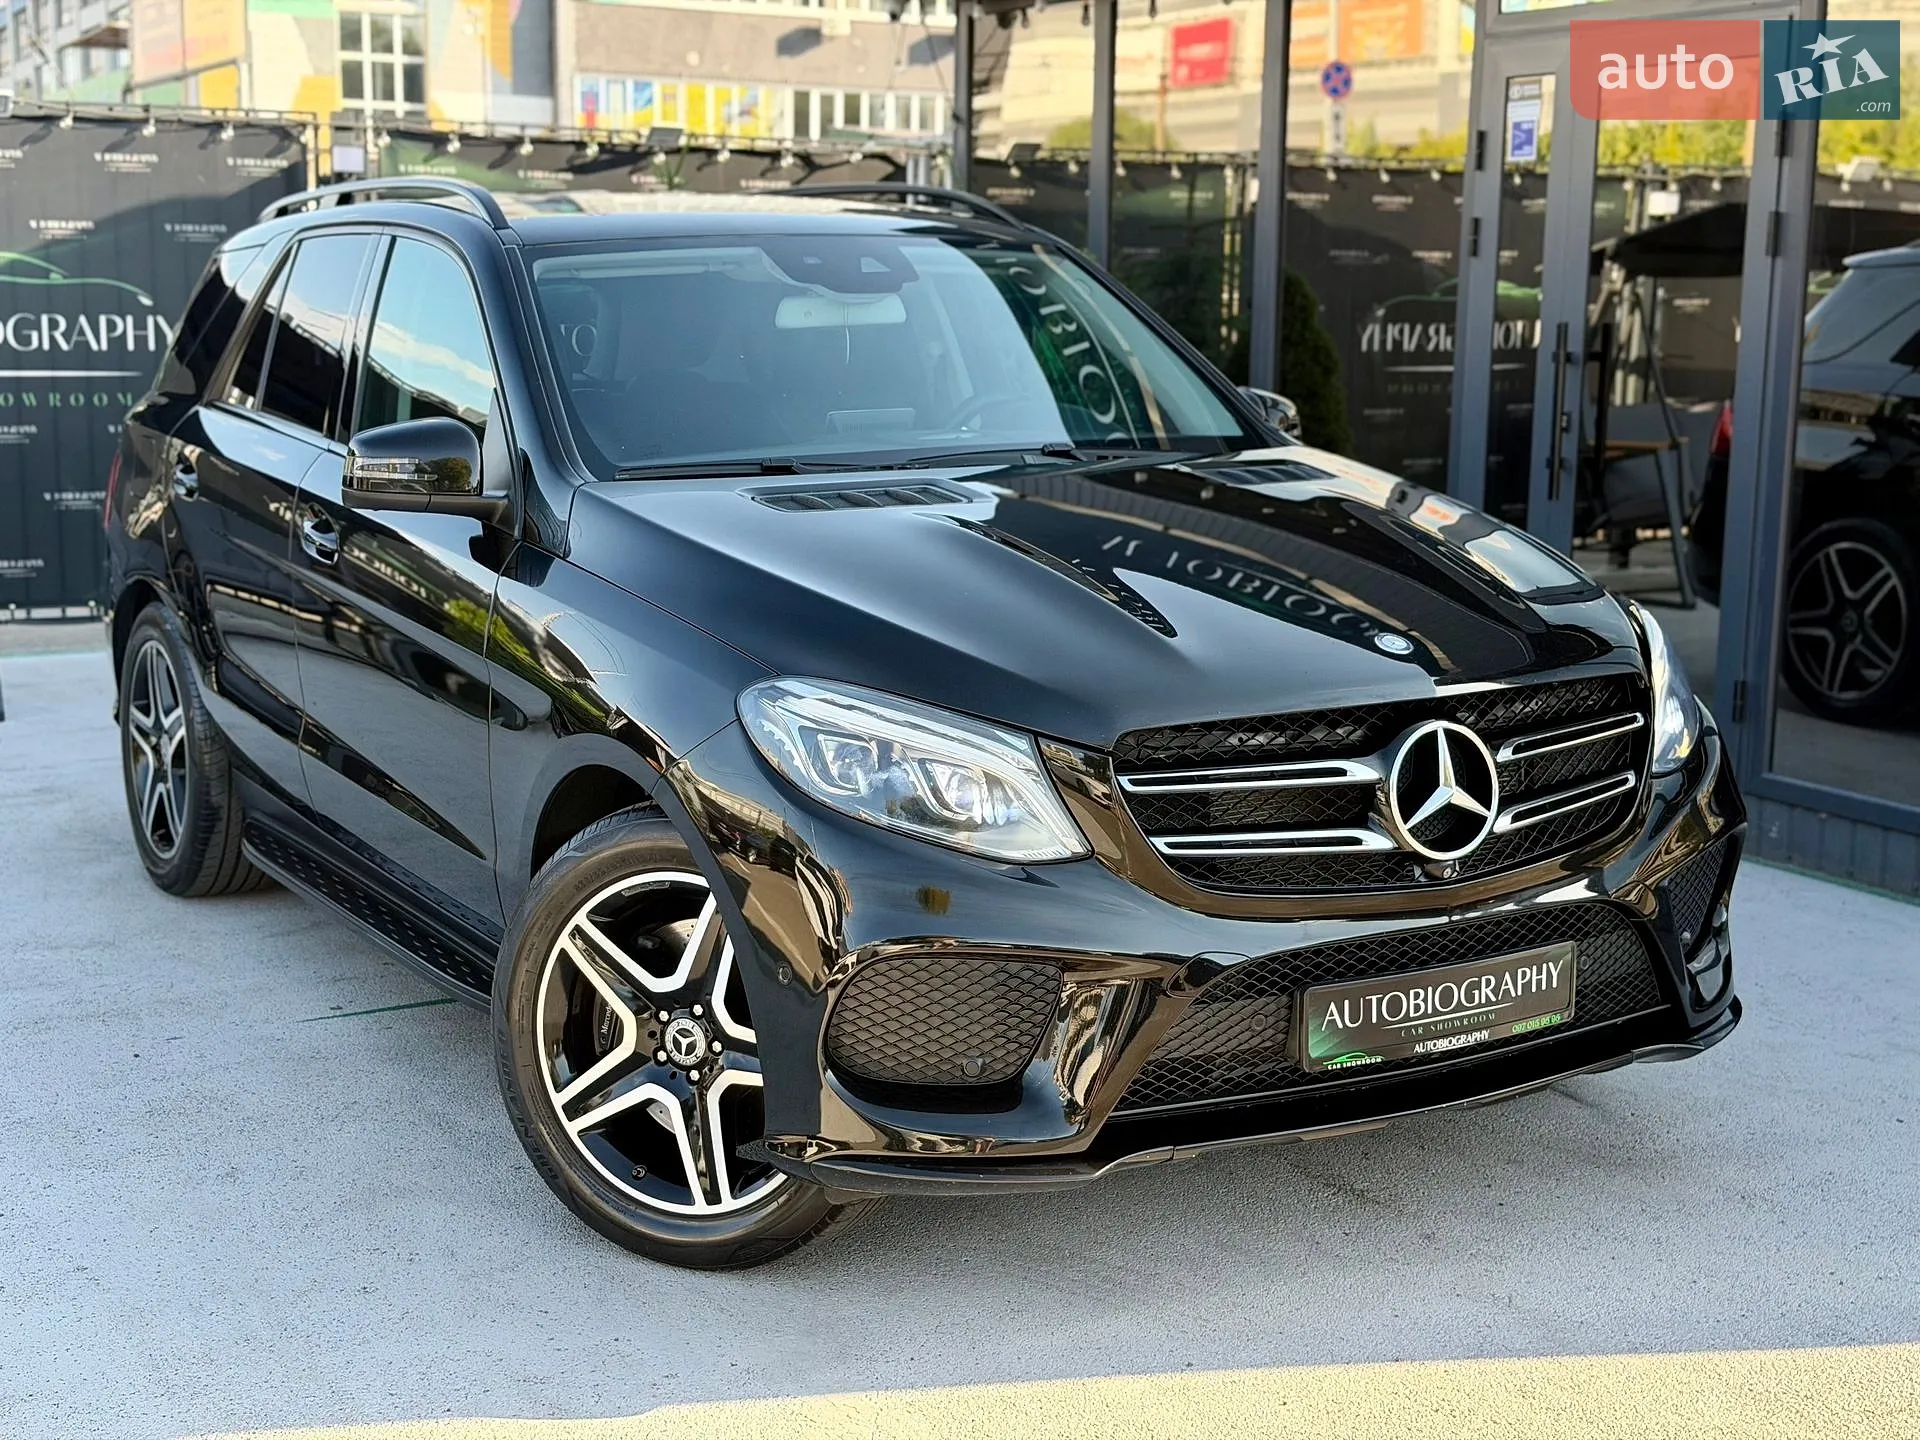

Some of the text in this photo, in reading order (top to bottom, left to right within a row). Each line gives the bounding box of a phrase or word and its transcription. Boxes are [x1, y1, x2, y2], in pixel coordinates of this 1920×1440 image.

[0, 312, 175, 352] GRAPHY
[1320, 959, 1564, 1032] AUTOBIOGRAPHY
[1401, 1012, 1498, 1038] CAR SHOWROOM
[1413, 1029, 1490, 1054] AUTOBIOGRAPHY
[1342, 1057, 1382, 1068] SHOWROOM
